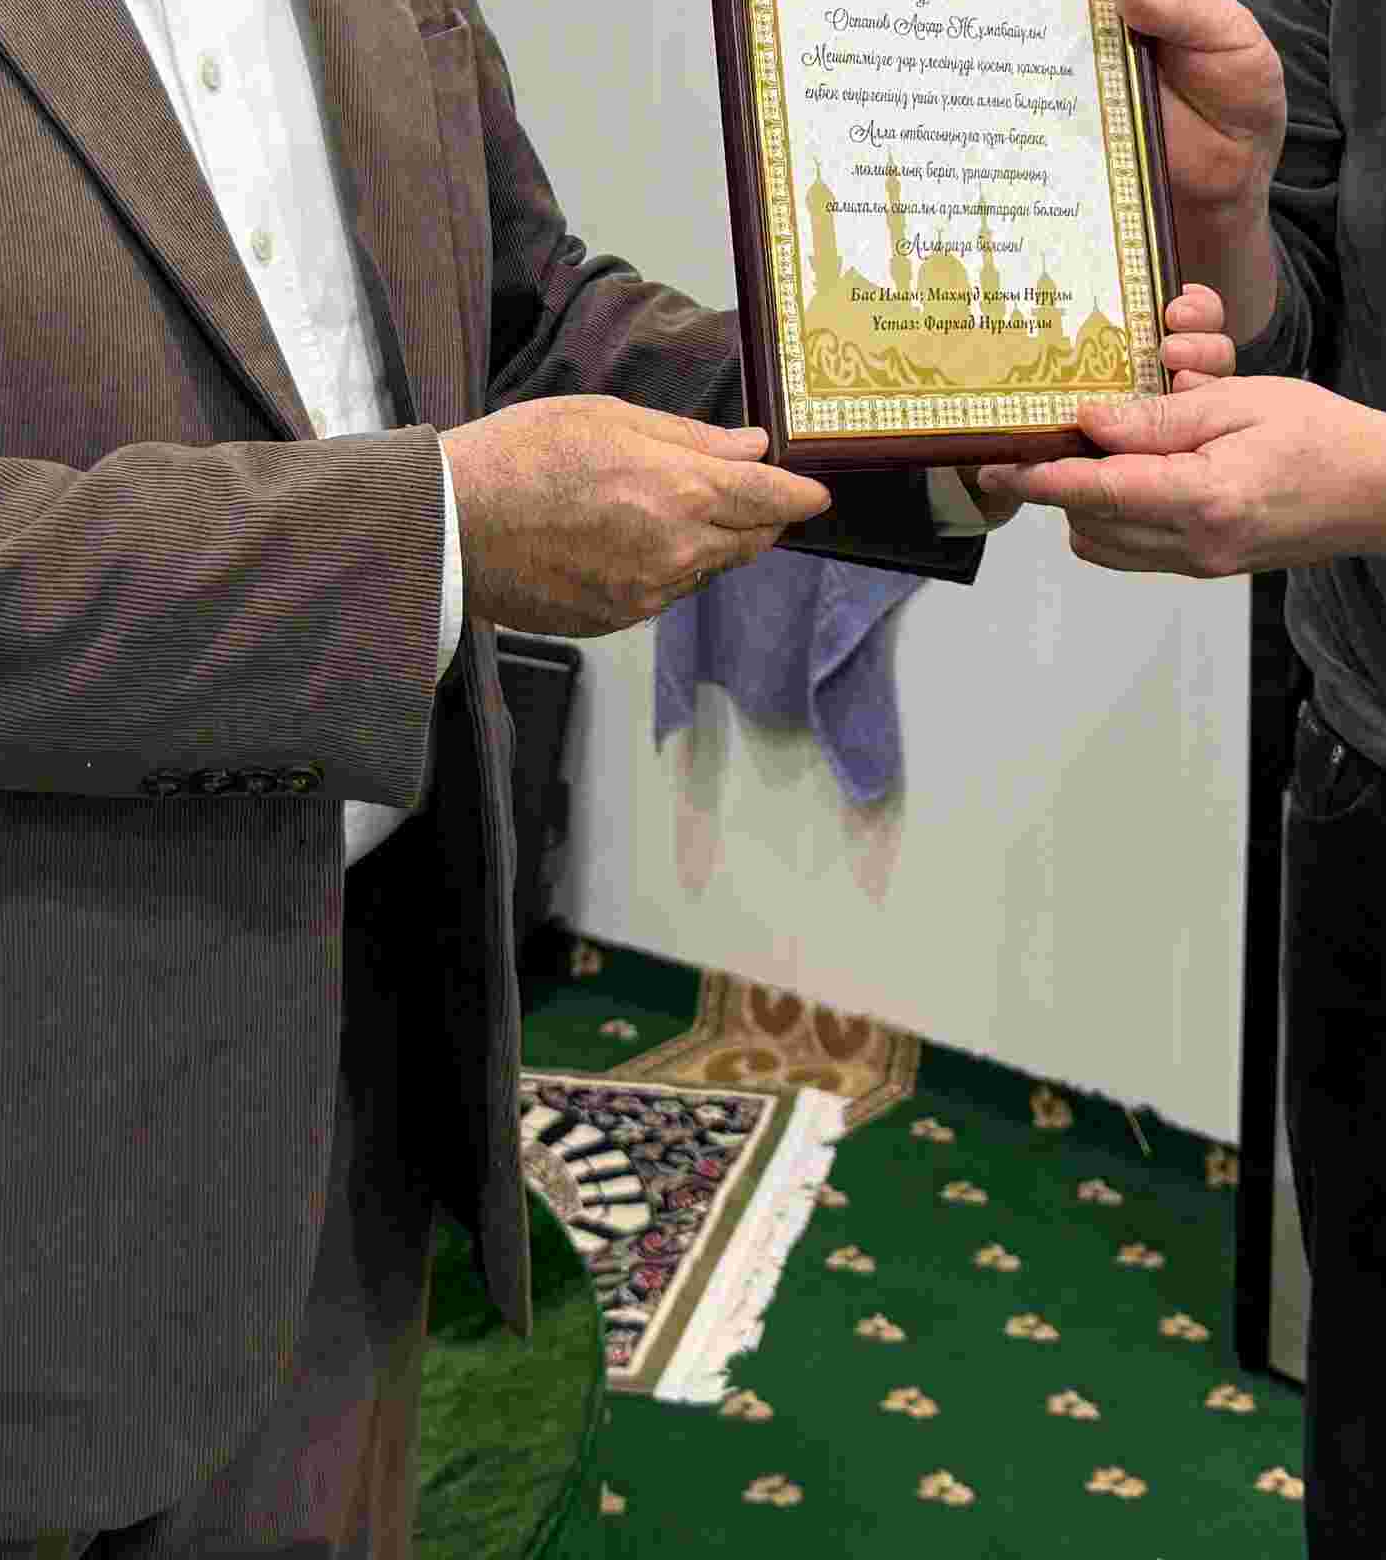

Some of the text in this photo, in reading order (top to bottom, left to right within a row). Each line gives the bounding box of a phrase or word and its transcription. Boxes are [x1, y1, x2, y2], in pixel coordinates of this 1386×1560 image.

[823, 6, 891, 31] Оспанов
[851, 287, 877, 303] Бас
[923, 314, 977, 335] Фархад
